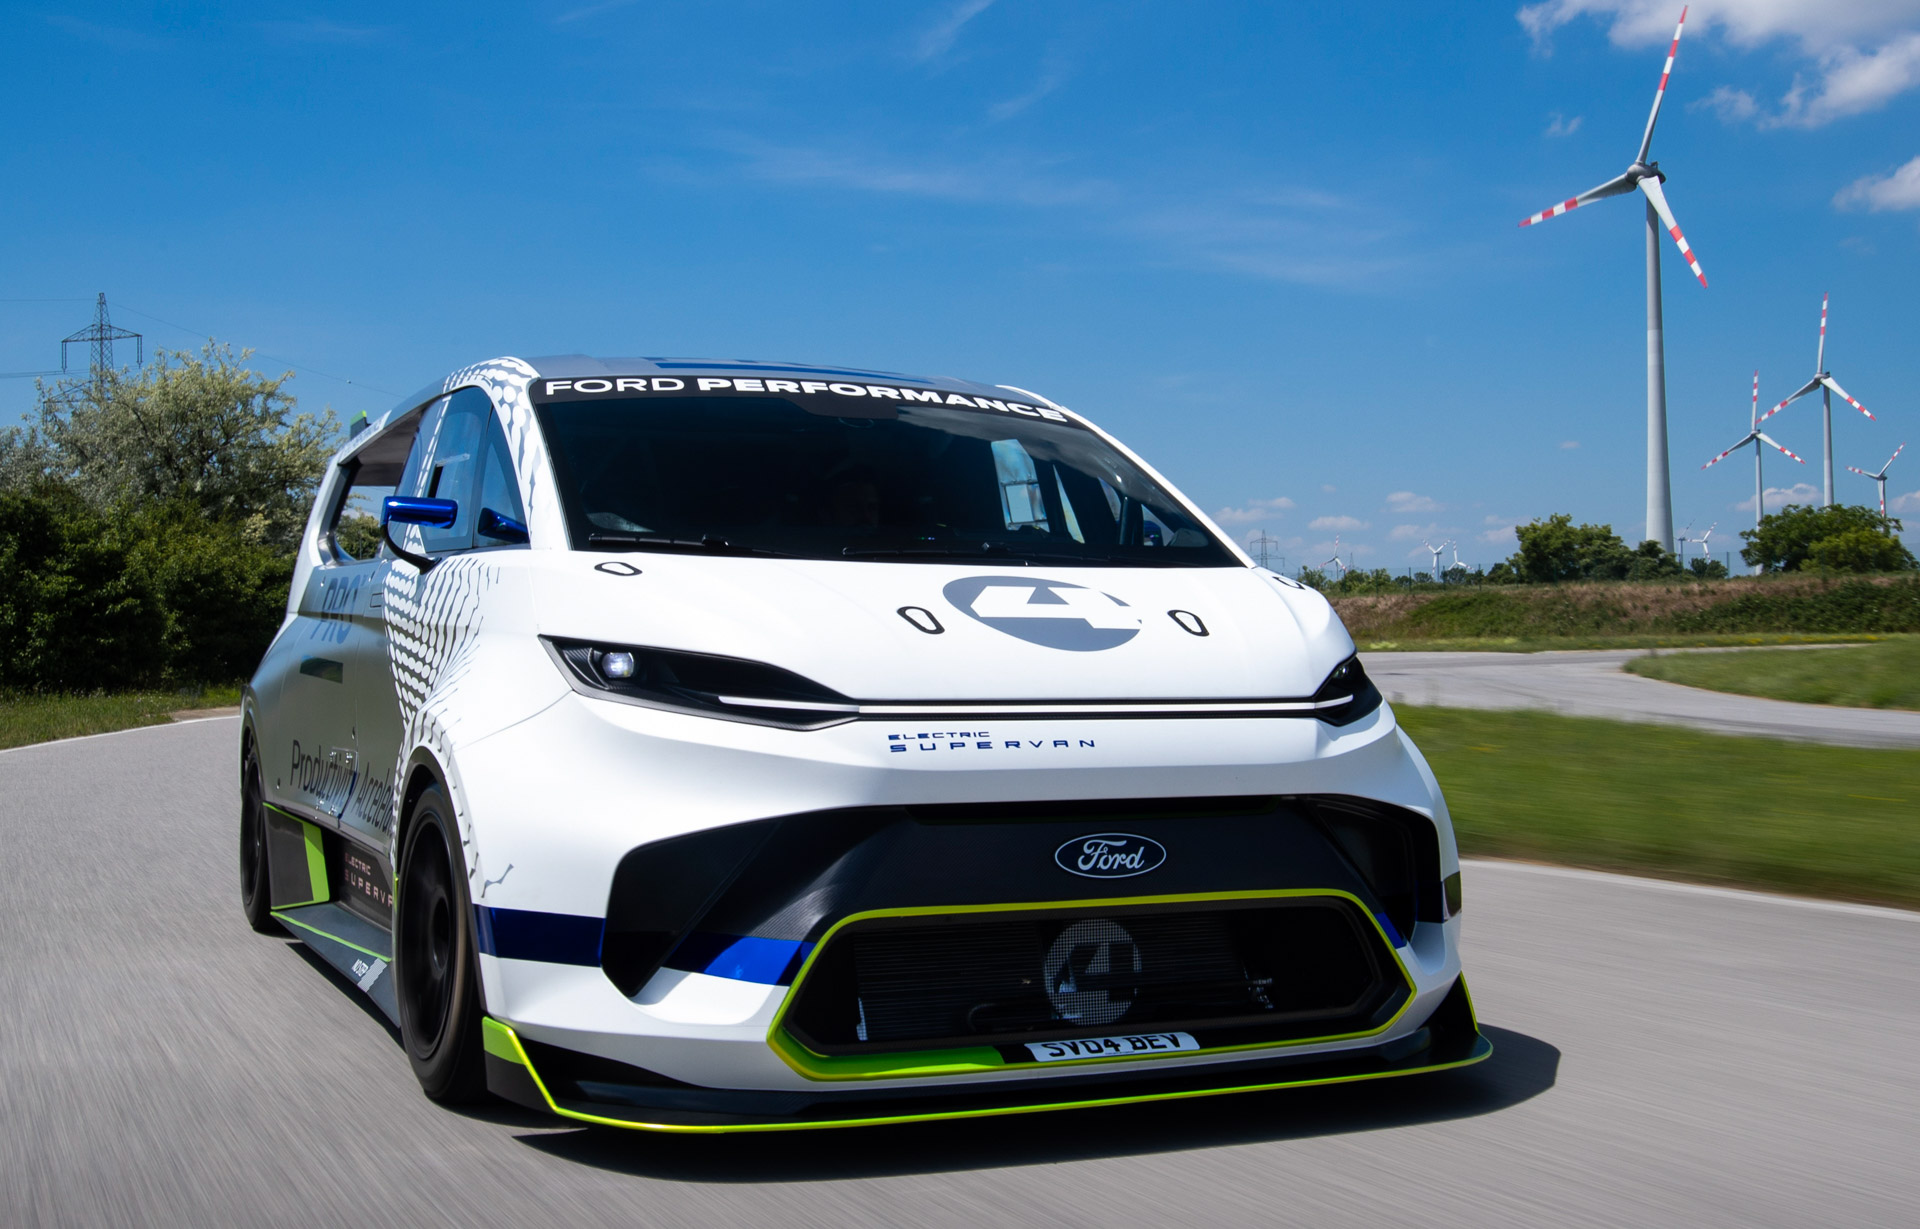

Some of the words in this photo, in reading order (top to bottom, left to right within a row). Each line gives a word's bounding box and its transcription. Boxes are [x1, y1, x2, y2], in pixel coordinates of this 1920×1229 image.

[545, 377, 685, 396] FORD
[698, 378, 1069, 423] PERFORMANCE
[888, 731, 990, 741] ELECTRIC
[890, 739, 1096, 753] SUPERVAN
[1077, 839, 1145, 871] Ford
[1041, 1038, 1121, 1058] SV04
[1123, 1033, 1181, 1051] BEV
